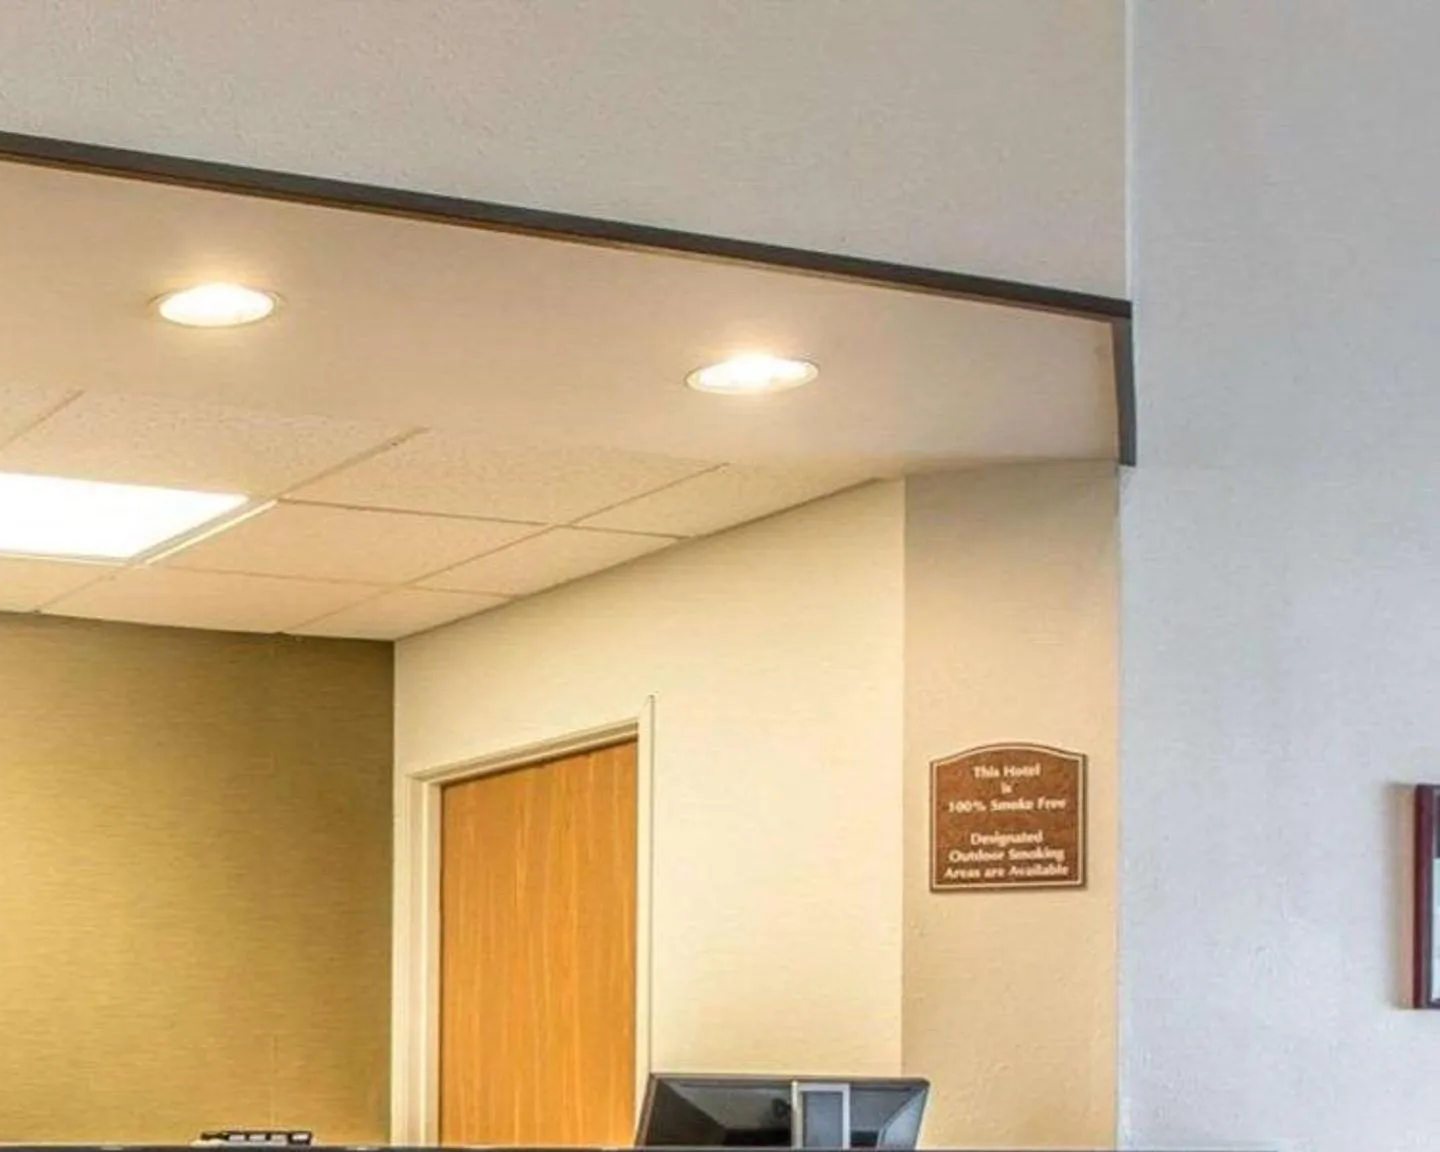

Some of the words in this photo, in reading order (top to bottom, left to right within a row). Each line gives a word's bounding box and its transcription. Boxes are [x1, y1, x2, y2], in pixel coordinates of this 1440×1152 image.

[948, 800, 987, 813] 100%
[990, 797, 1034, 811] Smoke
[1037, 796, 1066, 810] Free
[970, 829, 1043, 847] Designated
[948, 849, 1005, 863] Outdoor
[1008, 846, 1066, 863] Smoking
